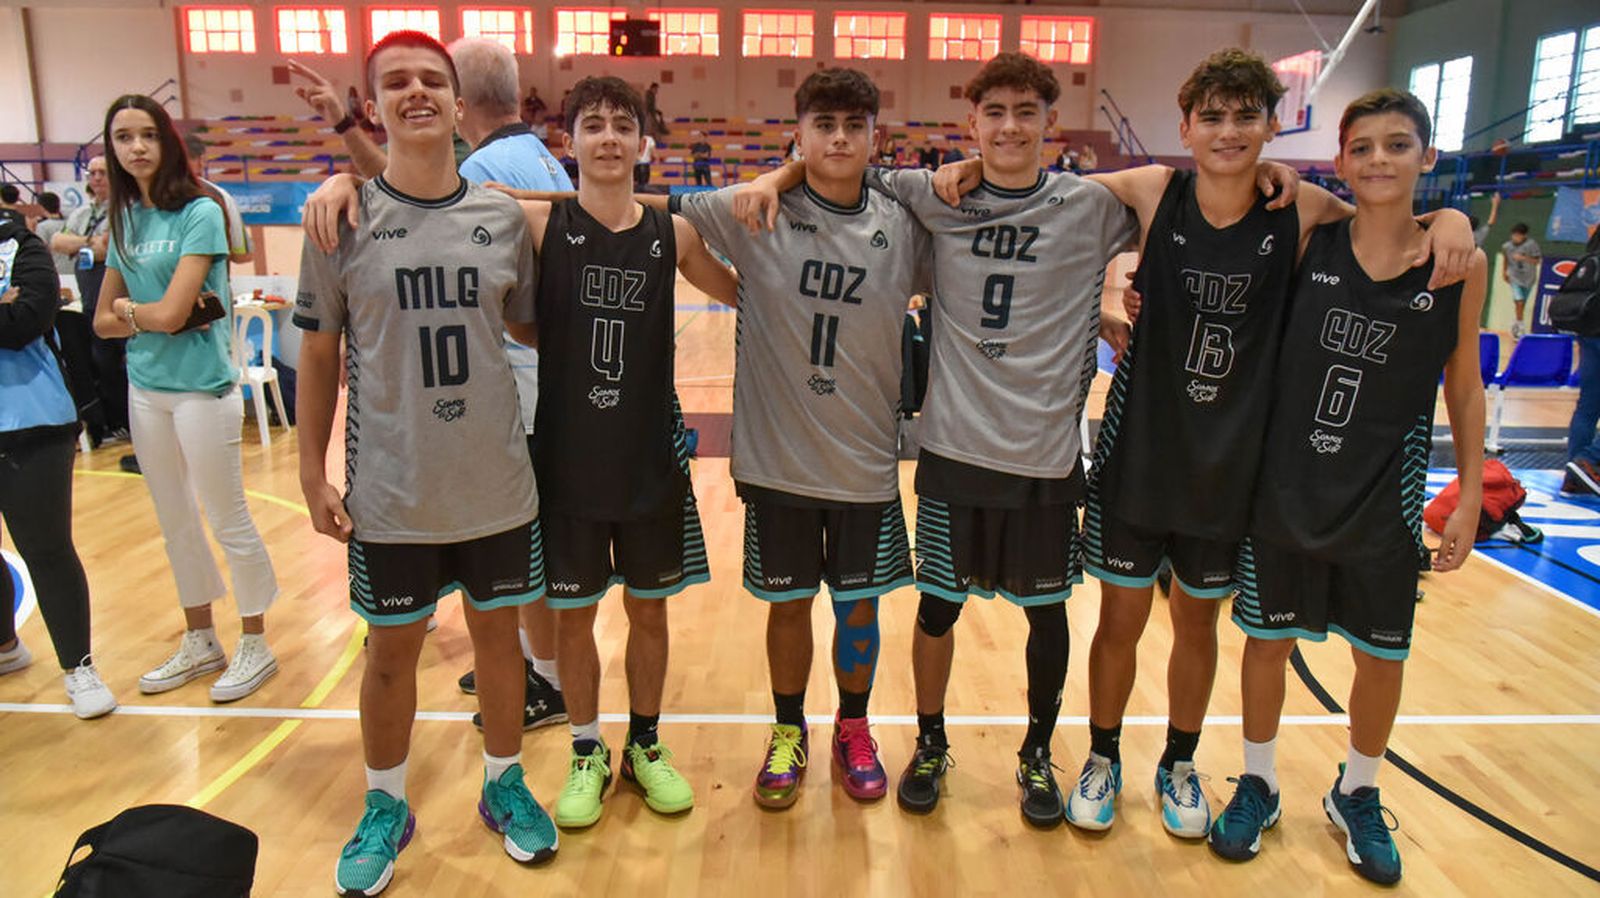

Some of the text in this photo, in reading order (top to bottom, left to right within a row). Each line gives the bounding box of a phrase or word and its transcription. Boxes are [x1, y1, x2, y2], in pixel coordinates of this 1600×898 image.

[372, 227, 408, 240] vive
[790, 220, 818, 233] vive
[971, 224, 1040, 263] CDZ
[395, 266, 479, 310] MLG
[580, 264, 647, 311] CDZ
[799, 259, 867, 305] CDZ
[1311, 271, 1340, 286] vive
[981, 273, 1015, 329] 9
[419, 324, 470, 388] 10
[591, 318, 625, 381] 4
[811, 312, 840, 367] 11
[1320, 307, 1397, 364] CDZ
[1315, 364, 1363, 427] 6
[768, 576, 793, 585] vive
[1107, 556, 1135, 570] vive
[382, 595, 414, 607] vive
[551, 581, 581, 592] vive
[1269, 612, 1296, 622] vive
